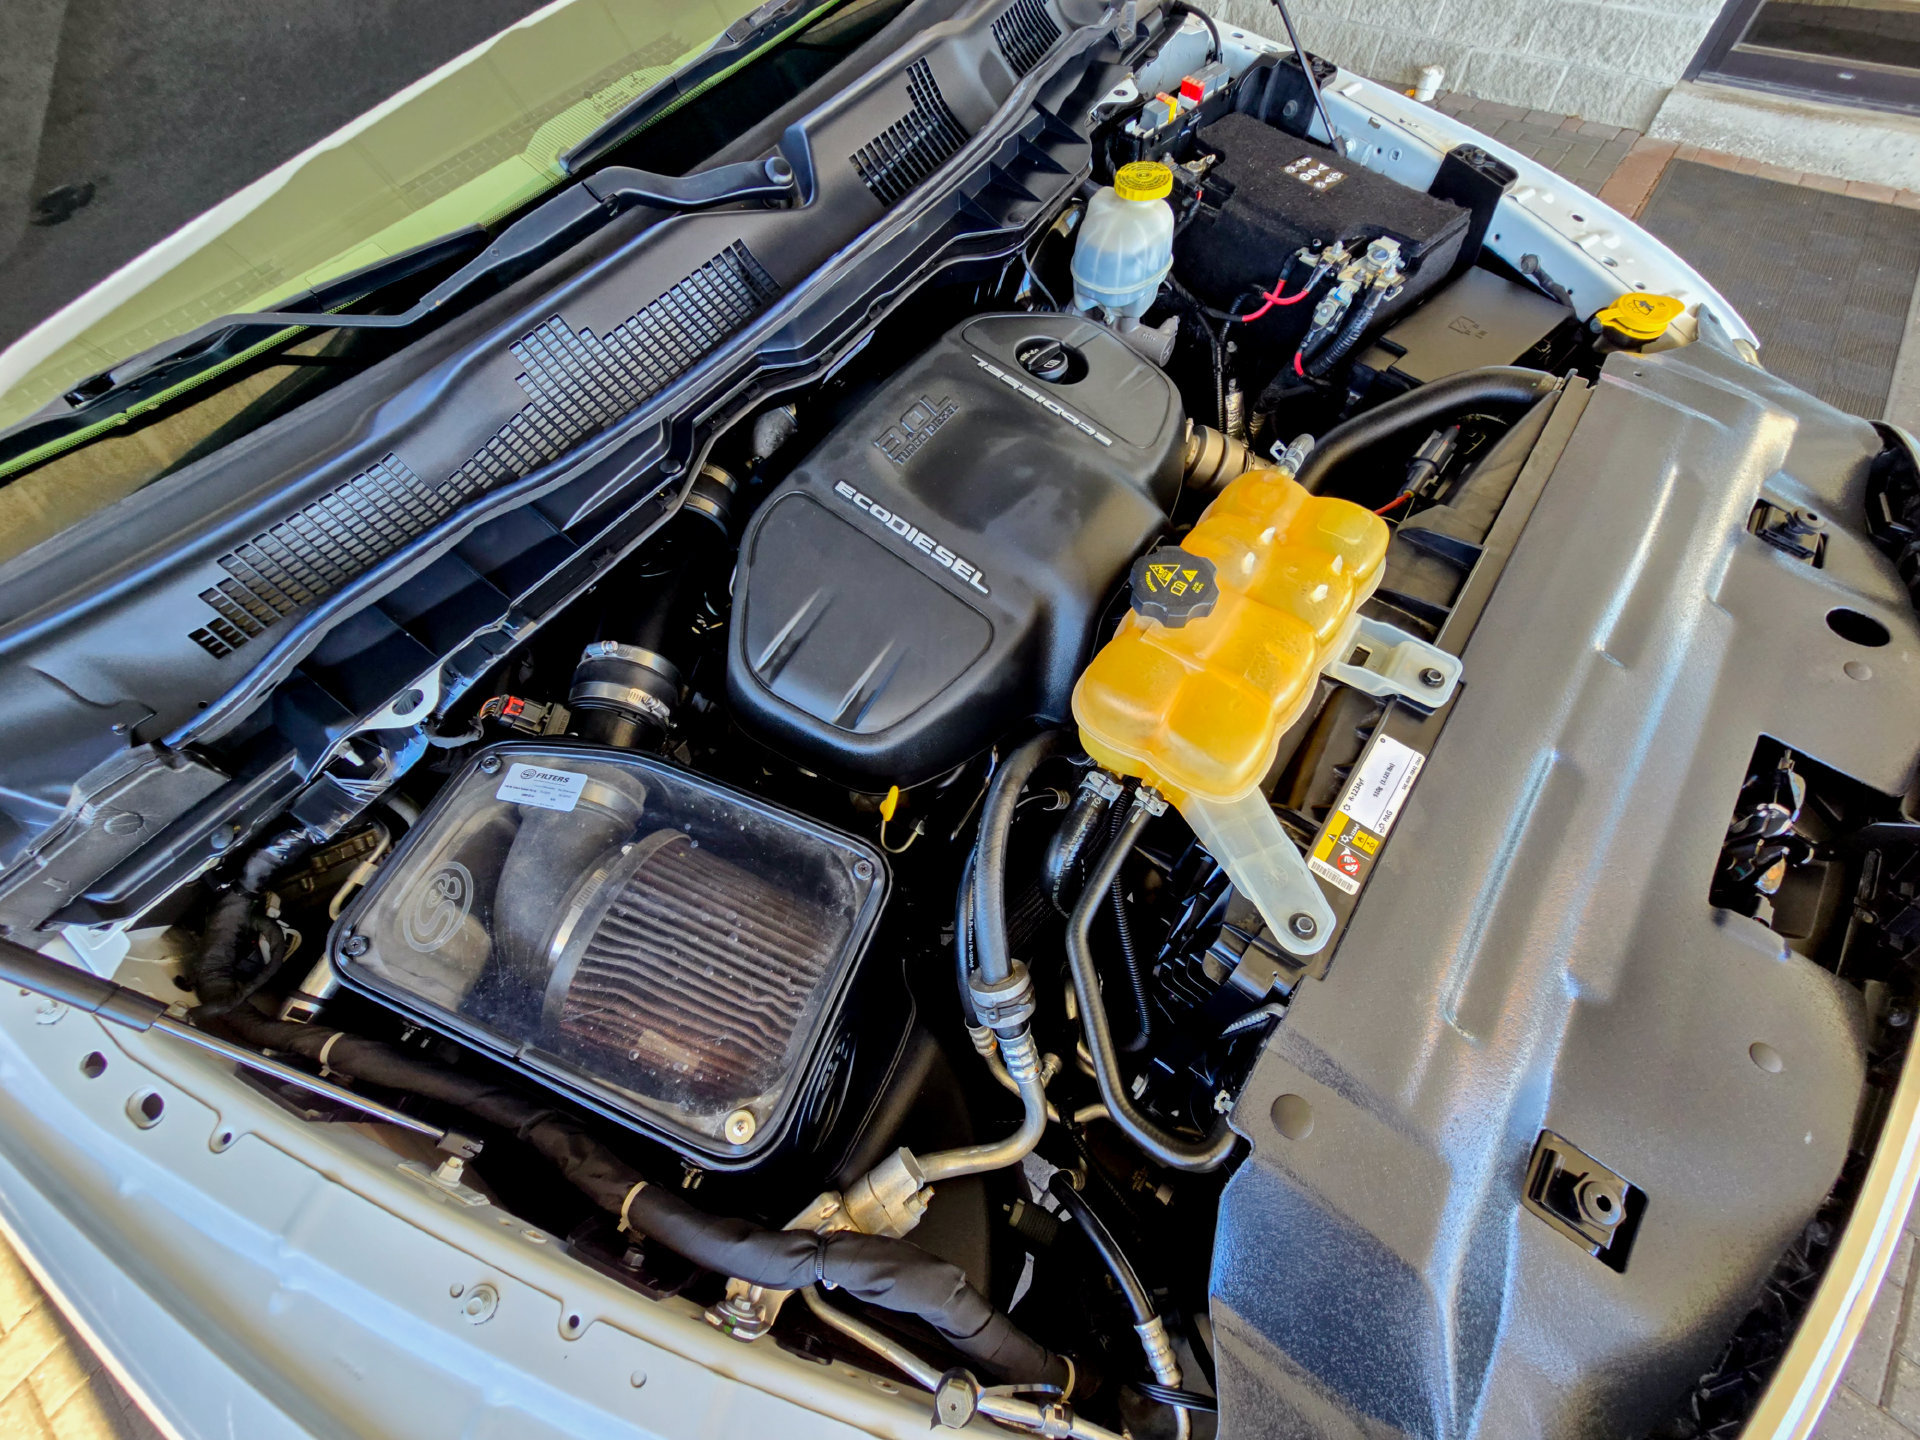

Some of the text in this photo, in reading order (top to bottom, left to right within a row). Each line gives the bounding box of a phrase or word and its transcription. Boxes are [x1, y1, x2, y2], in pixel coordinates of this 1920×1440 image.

[971, 353, 1113, 447] ECODIESEL
[833, 480, 989, 594] ECODIESEL
[535, 772, 570, 783] FILTERS
[1348, 777, 1364, 802] R-1234yf
[1382, 810, 1393, 822] PAG
